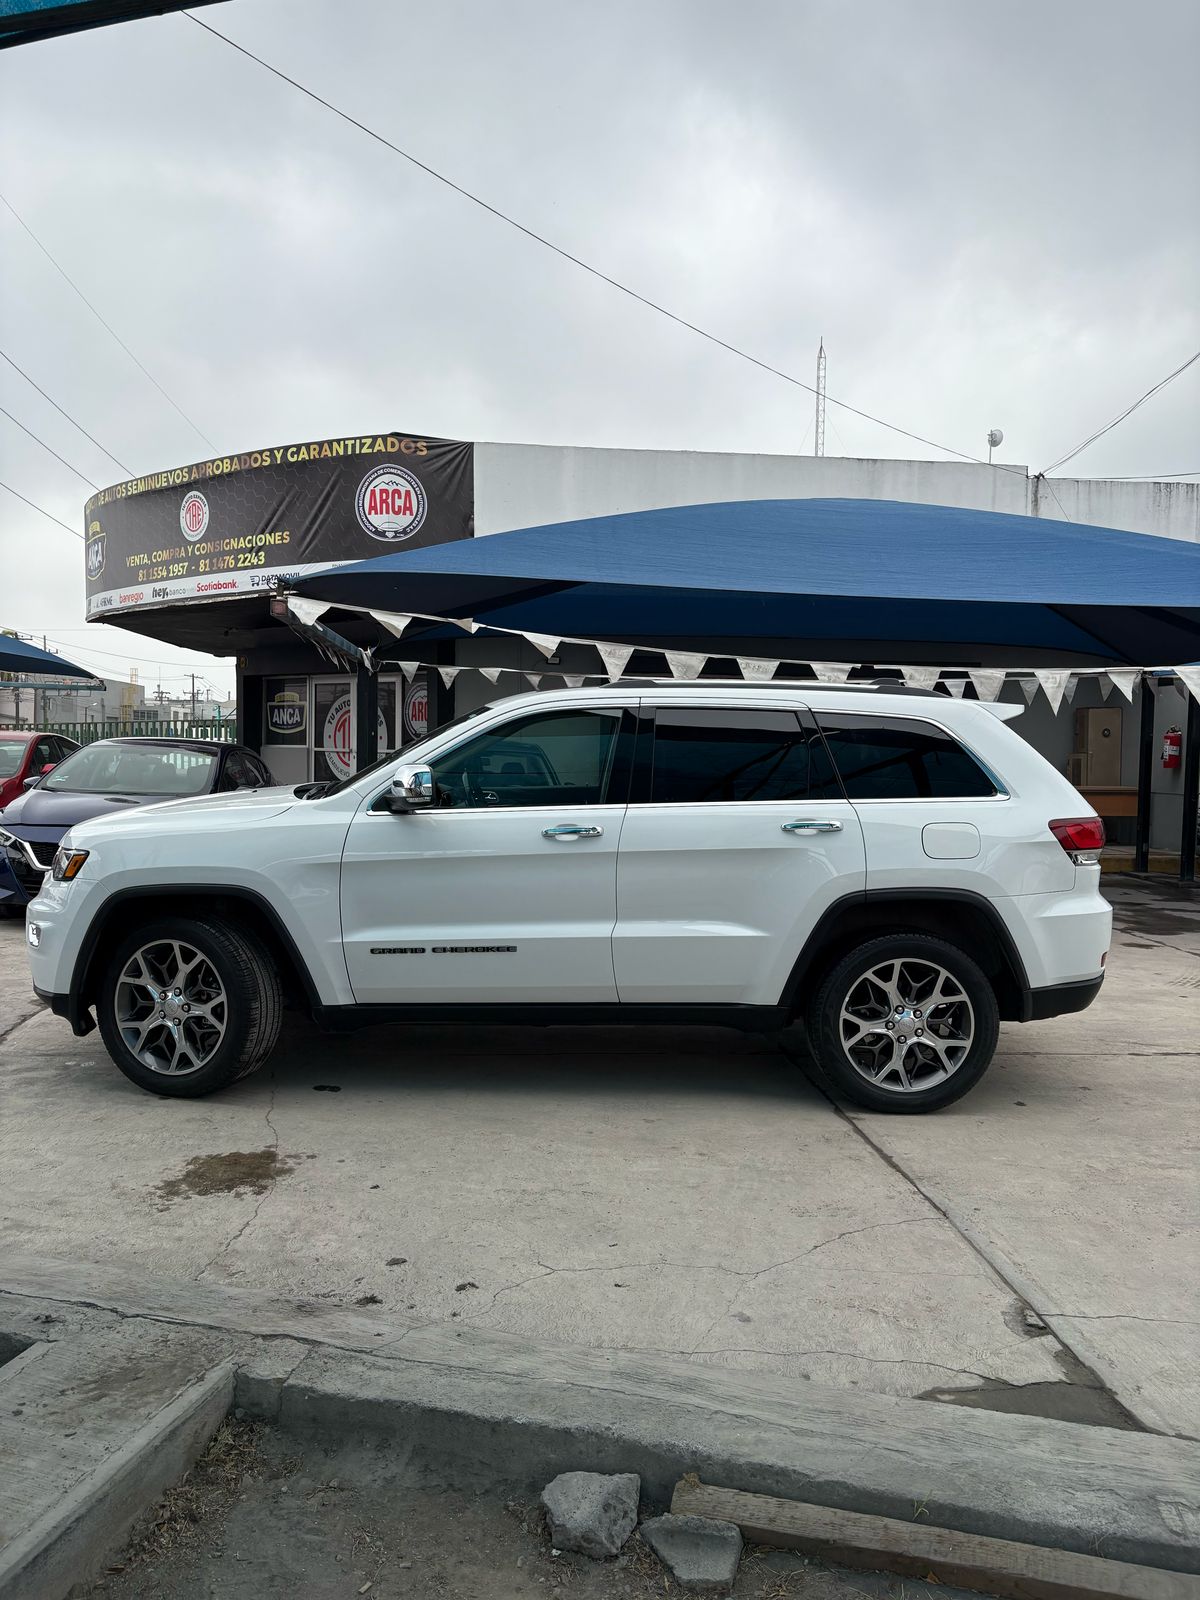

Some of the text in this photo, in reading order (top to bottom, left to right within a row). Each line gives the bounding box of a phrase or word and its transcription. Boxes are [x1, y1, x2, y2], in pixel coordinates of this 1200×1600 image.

[105, 485, 127, 503] AUTOS
[128, 467, 189, 496] SEMINUEVOS
[191, 451, 271, 480] APROBADOS
[273, 448, 284, 464] Y
[287, 437, 429, 462] GARANTIZADOS
[367, 488, 414, 517] ARCA
[125, 531, 291, 568] VENTA, COMPRA Y CONSIGNACIONES
[138, 569, 147, 582] 81
[149, 566, 167, 580] 1554
[168, 562, 188, 577] 1957
[199, 559, 210, 572] 81
[212, 555, 235, 570] 1476
[237, 551, 265, 567] 2243
[196, 579, 238, 593] Scotiabank
[119, 592, 144, 605] banregio
[272, 708, 301, 725] ANCA
[328, 714, 336, 725] TU
[335, 700, 351, 715] AUTO
[411, 701, 428, 722] AR
[370, 945, 518, 955] GRAND CHEROKEE
